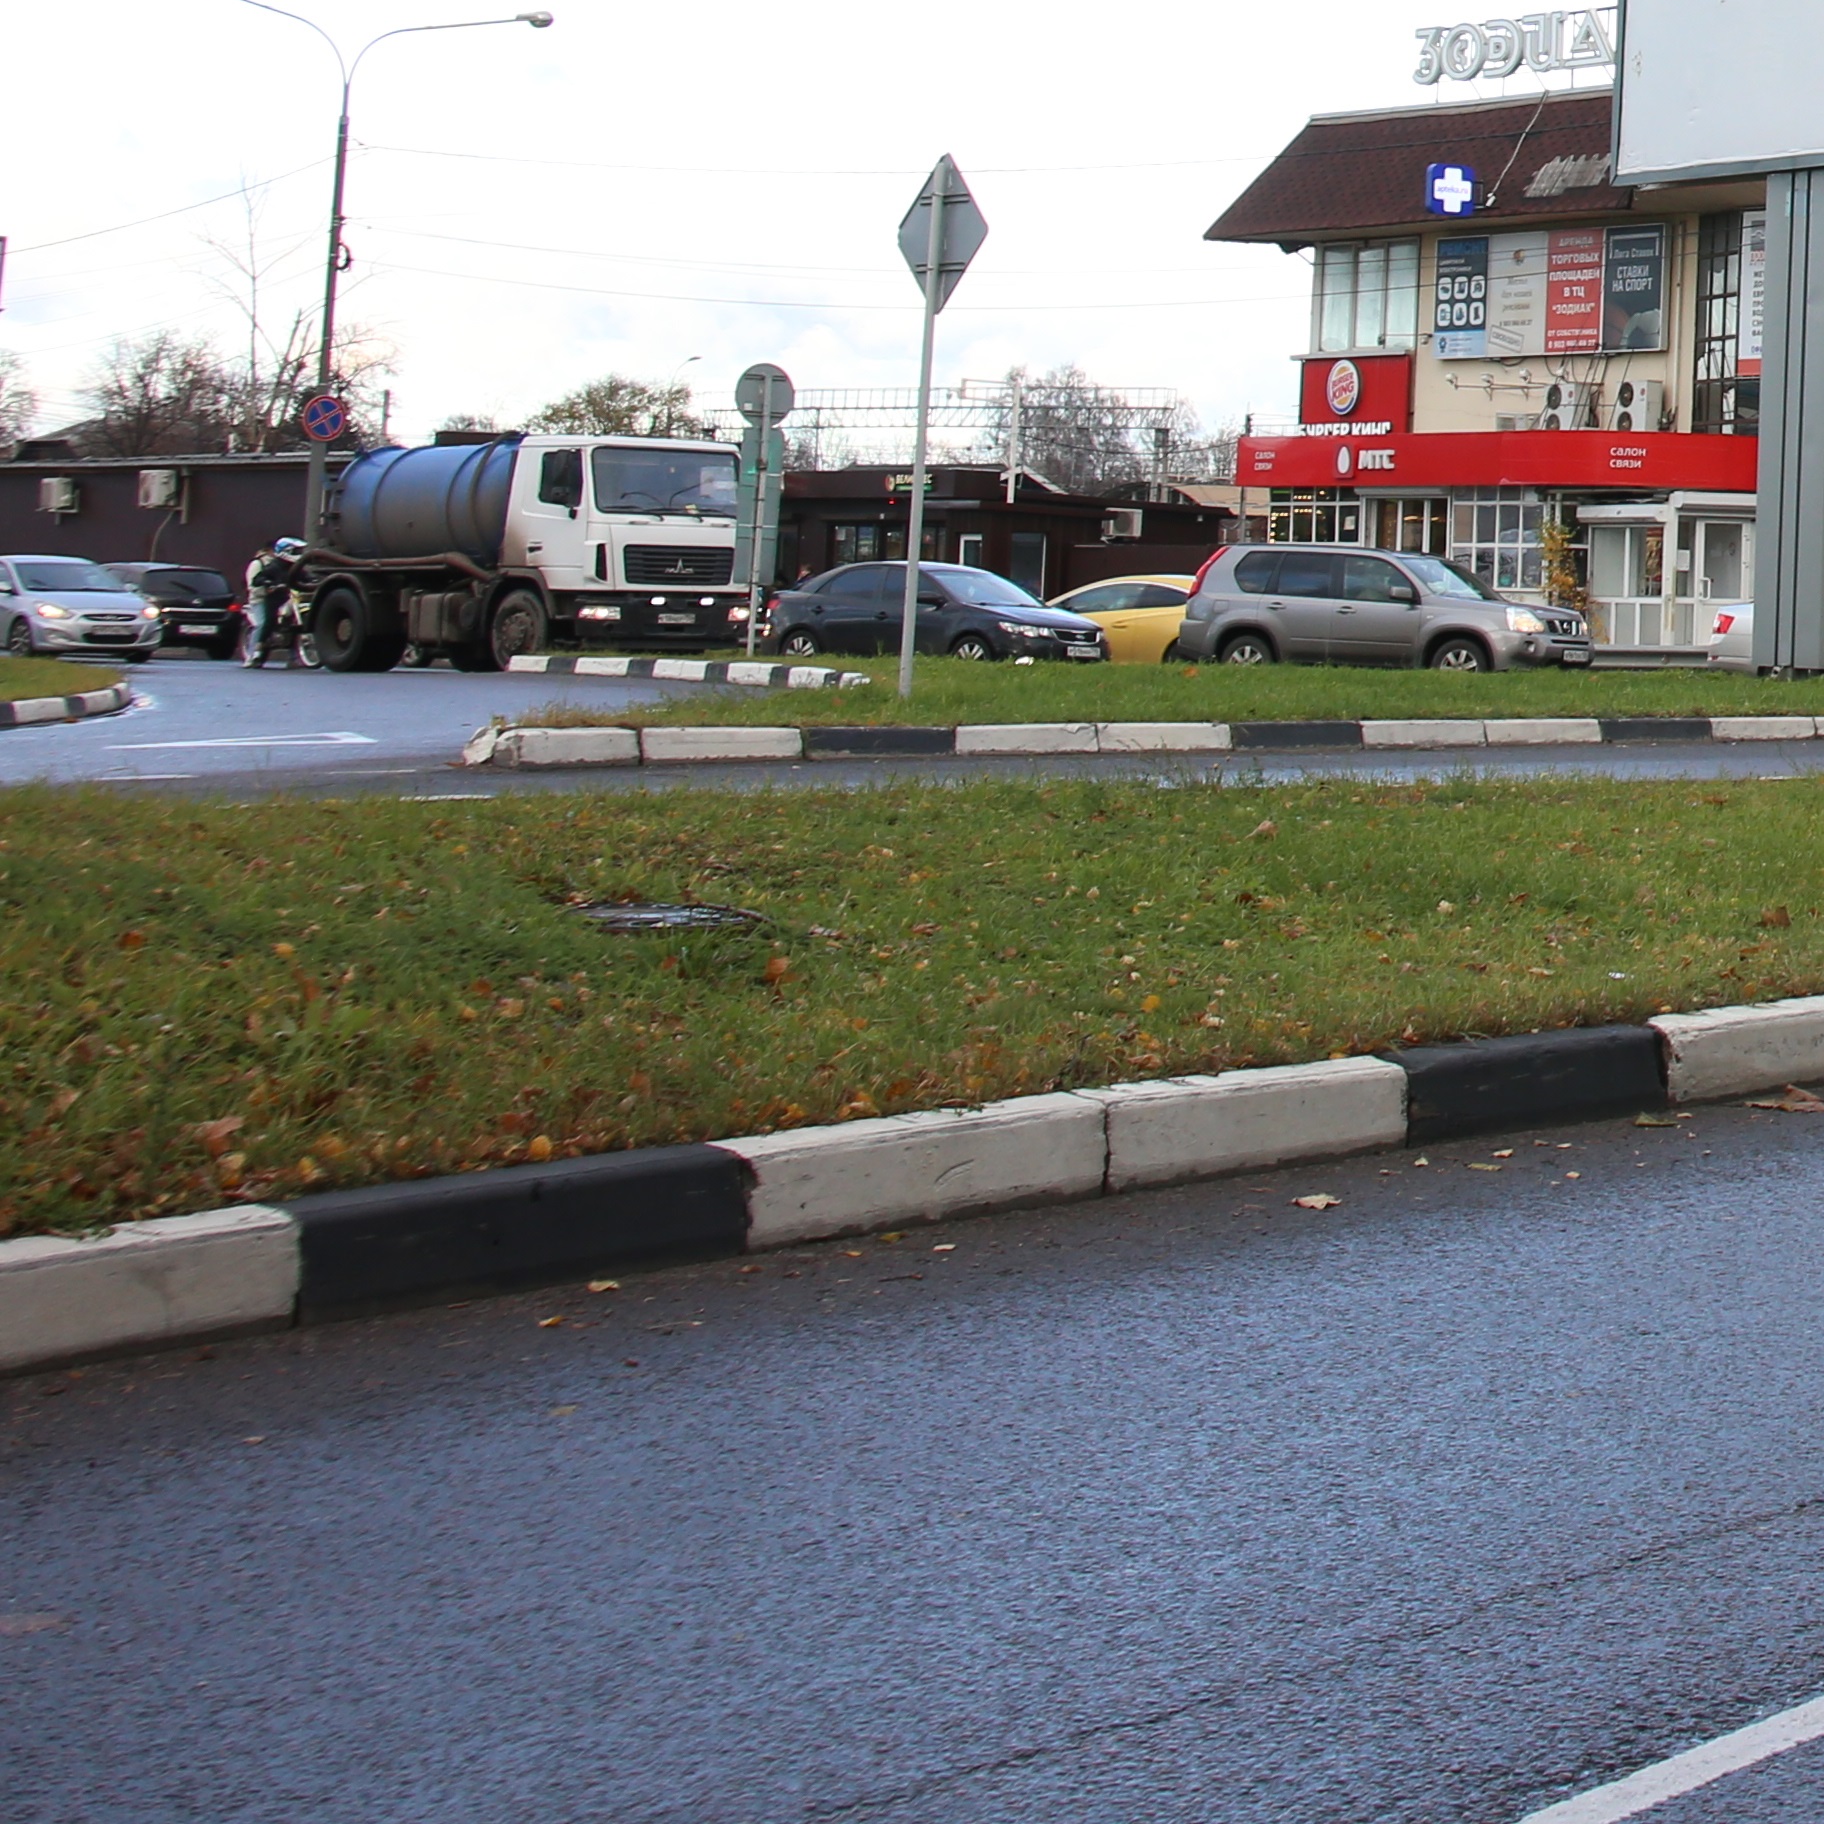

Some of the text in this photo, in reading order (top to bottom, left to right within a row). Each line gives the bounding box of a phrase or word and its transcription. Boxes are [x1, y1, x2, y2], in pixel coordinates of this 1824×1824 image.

[1559, 236, 1593, 247] АРЕНДА
[1551, 252, 1600, 265] ТОРГОВЫХ
[1549, 268, 1600, 282] ПЛОЩАДЕЙ
[1617, 265, 1650, 279] СТАВКИ
[1612, 277, 1653, 292] НА СПОРТ
[1563, 286, 1585, 298] В ТЦ
[1351, 421, 1392, 435] КИНГ
[1358, 449, 1395, 469] МТС
